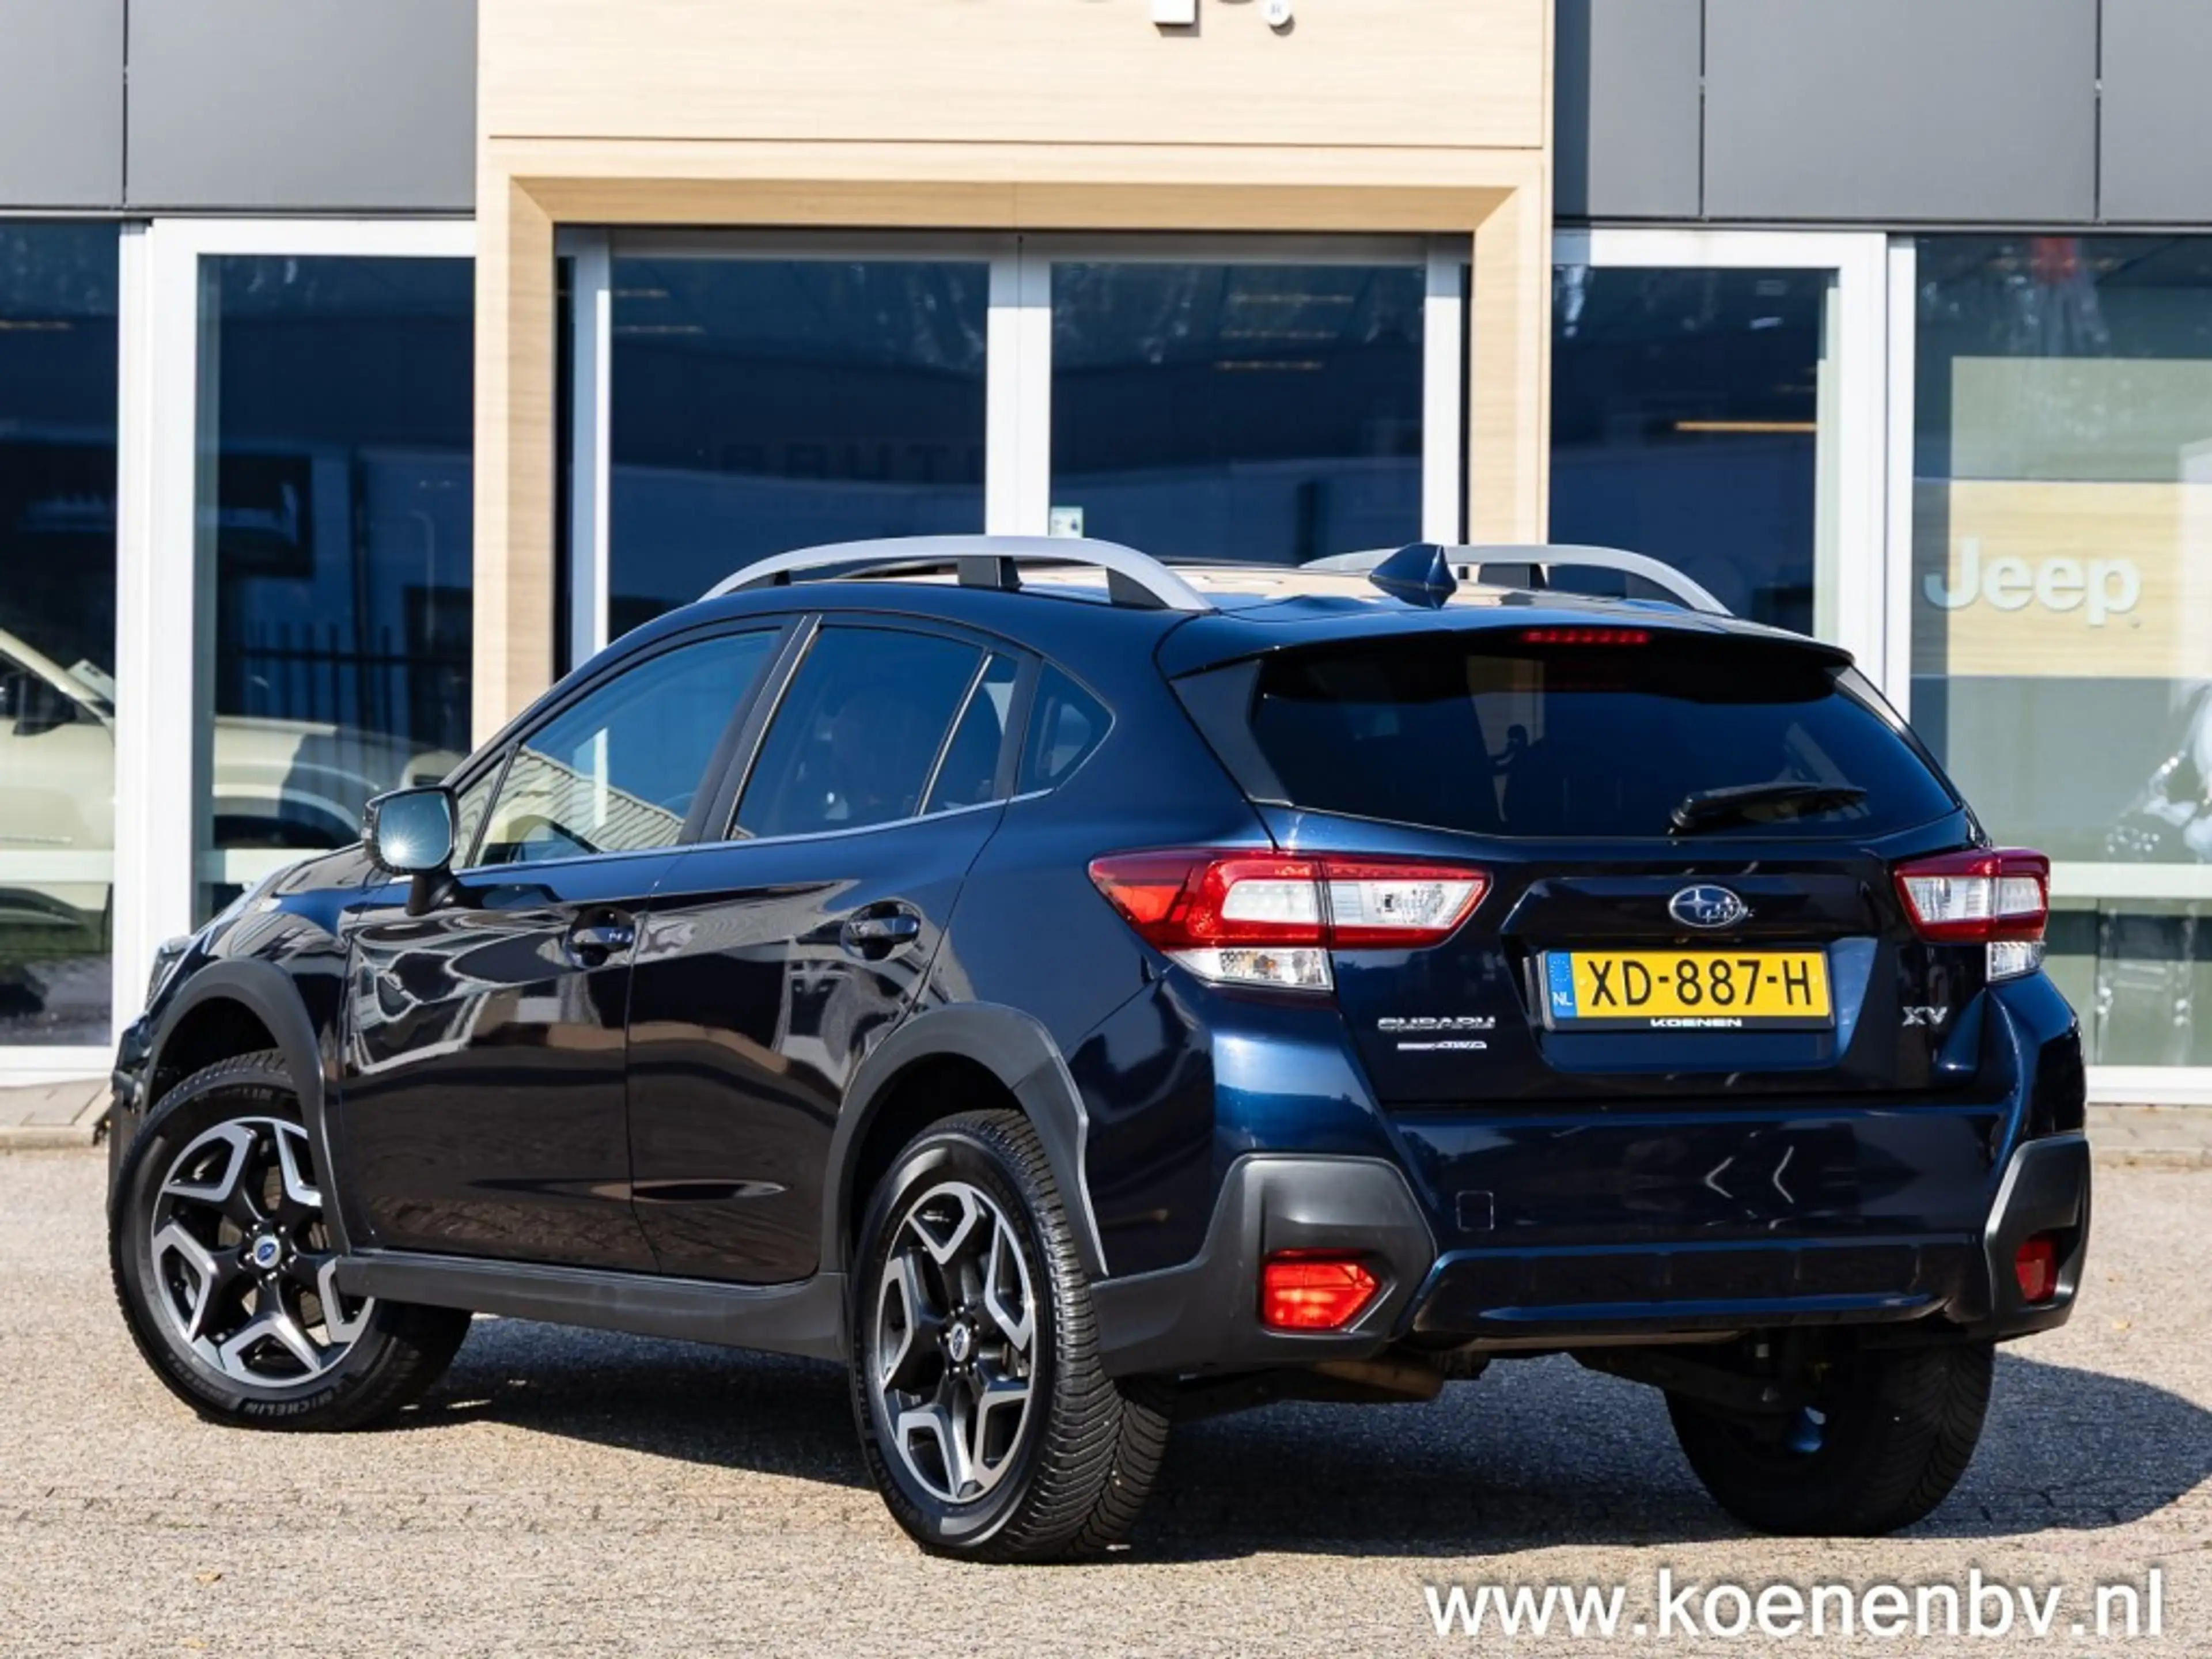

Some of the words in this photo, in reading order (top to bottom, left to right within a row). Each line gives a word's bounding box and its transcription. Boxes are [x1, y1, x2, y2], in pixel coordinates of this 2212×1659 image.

[1924, 537, 2141, 626] Jeep
[1588, 959, 1812, 1007] XD-887-H
[1552, 991, 1574, 1006] NL
[1650, 1017, 1742, 1027] KOENEN
[1902, 1006, 1948, 1026] XV
